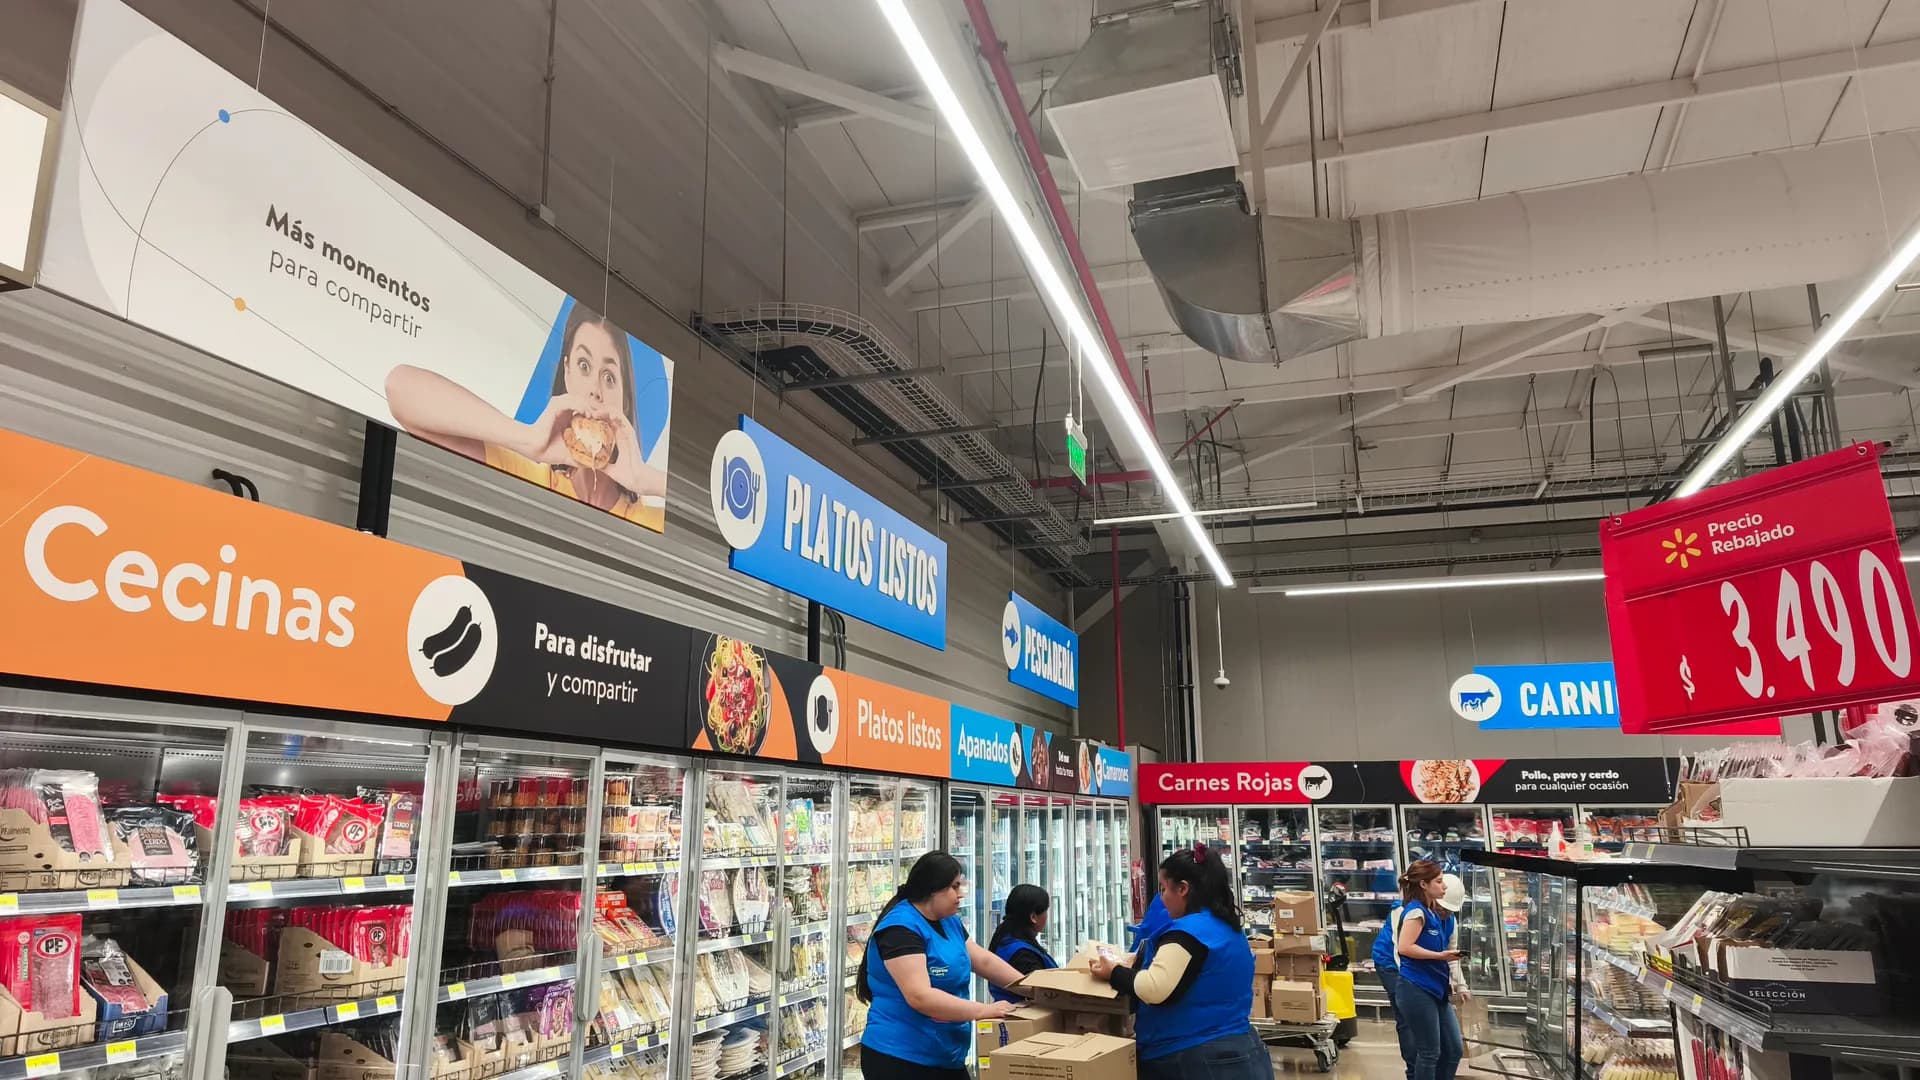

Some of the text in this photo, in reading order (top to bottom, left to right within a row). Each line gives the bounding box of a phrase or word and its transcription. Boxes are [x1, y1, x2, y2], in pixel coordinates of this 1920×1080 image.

[266, 204, 431, 312] Más momentos
[269, 250, 422, 338] para compartir
[1707, 513, 1763, 537] Precio
[1711, 523, 1795, 555] Rebajado
[783, 474, 938, 616] PLATOS LISTOS
[24, 505, 356, 648] Cecinas
[1679, 549, 1911, 701] $ 3.490
[534, 622, 652, 672] Para disfrutar
[1024, 624, 1075, 692] PESCADERÍA
[547, 671, 638, 705] y compartir
[1520, 680, 1619, 716] CARNI
[857, 698, 942, 751] Platos listos
[958, 723, 1009, 768] Apanados
[1103, 758, 1129, 782] Camarones
[1158, 772, 1293, 796] Carnes Rojas
[1515, 780, 1629, 792] para cualquier ocasión
[1521, 770, 1619, 783] Pollo, pavo y cerdo
[45, 938, 63, 953] PF
[1748, 989, 1806, 999] SELECCIÓN
